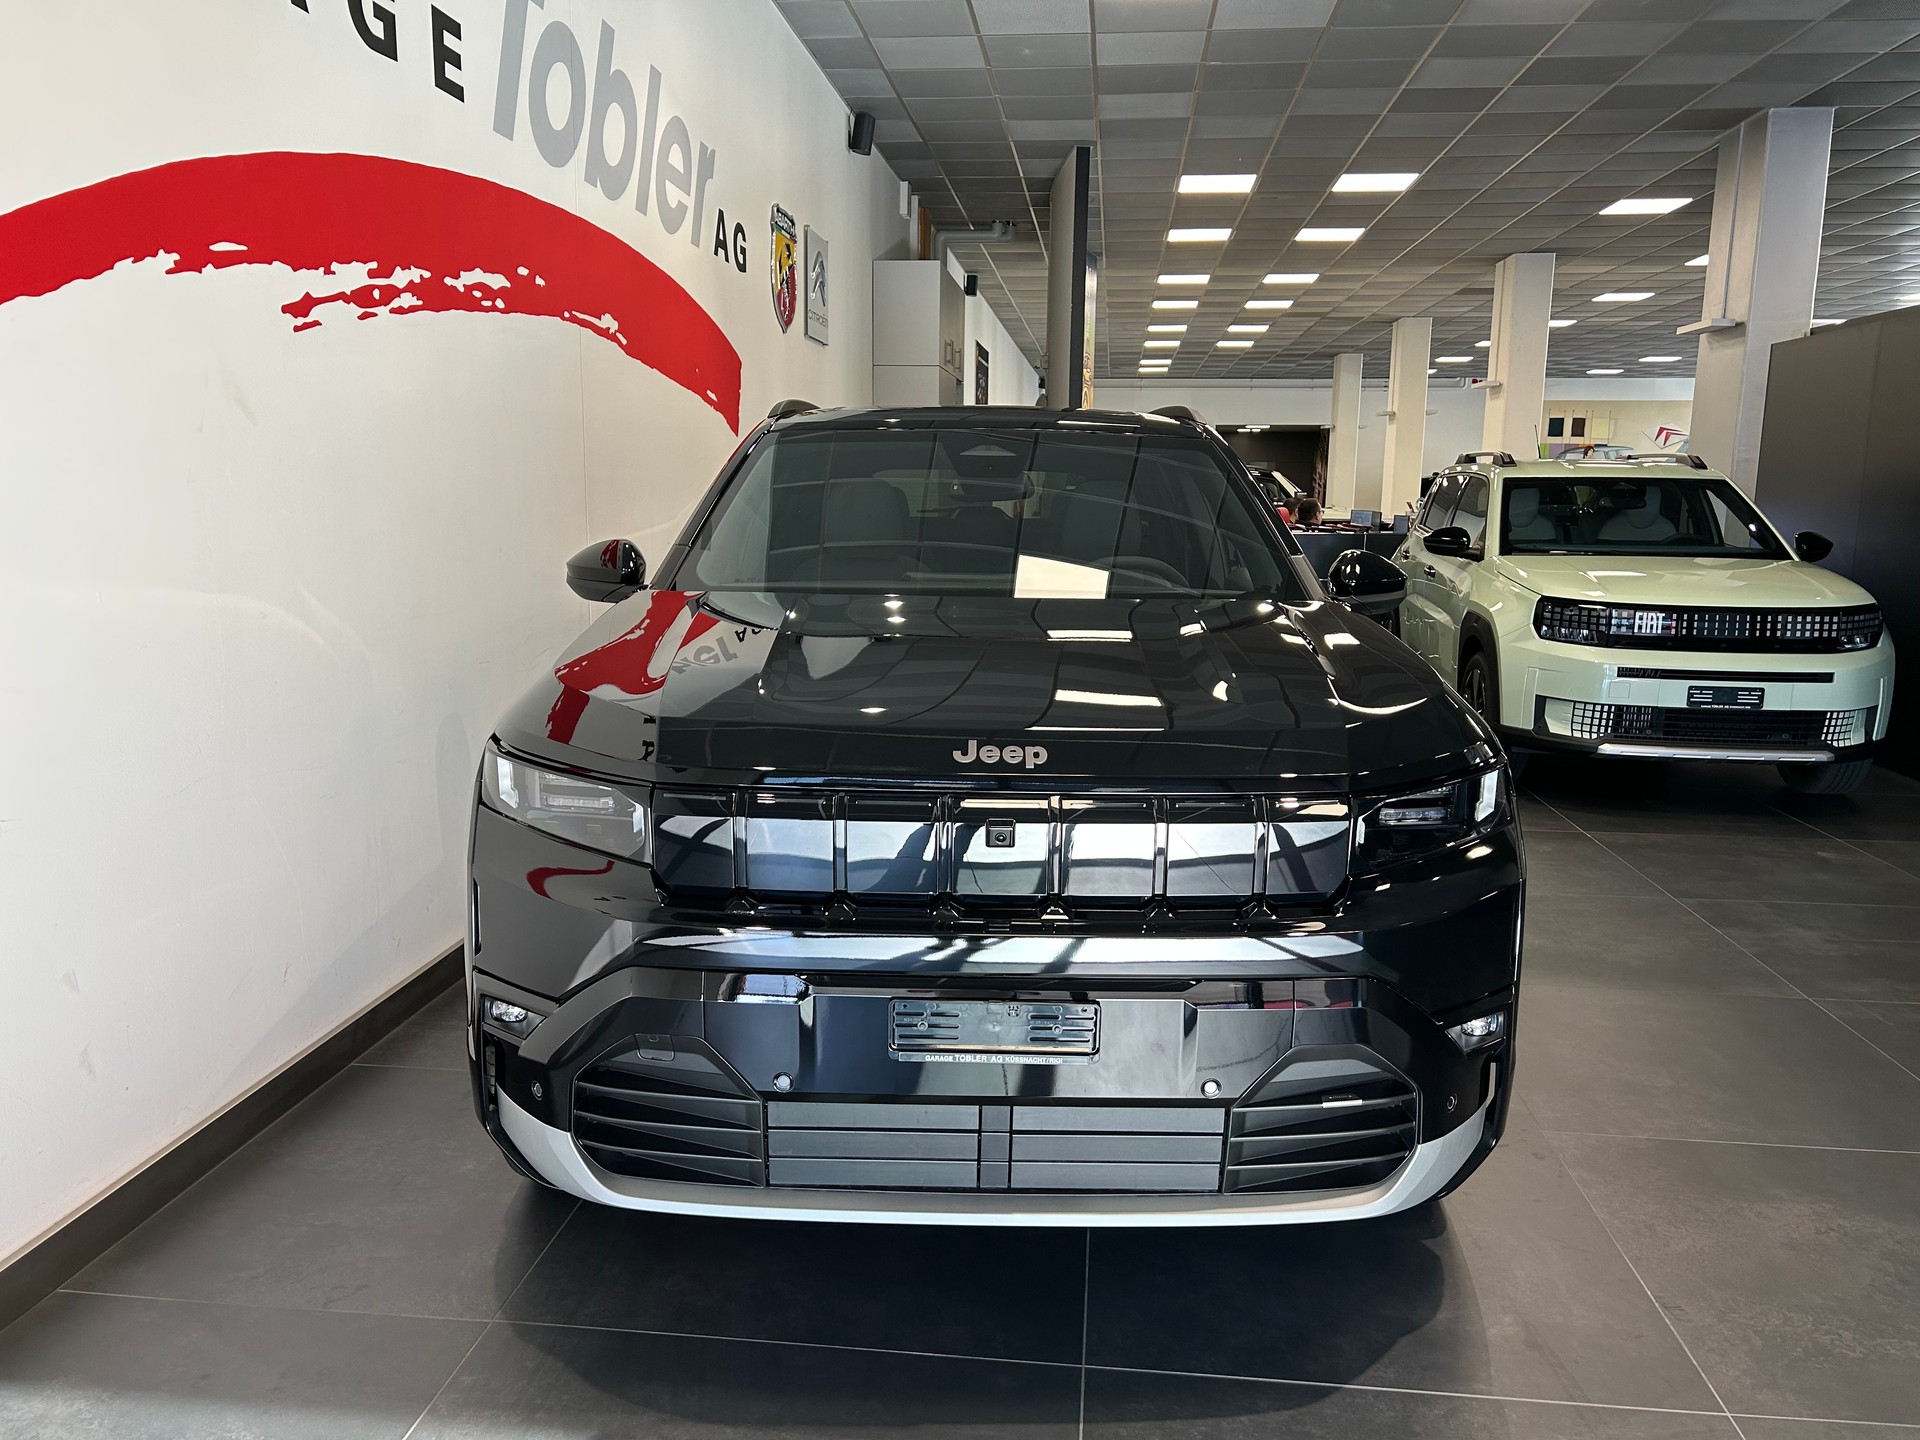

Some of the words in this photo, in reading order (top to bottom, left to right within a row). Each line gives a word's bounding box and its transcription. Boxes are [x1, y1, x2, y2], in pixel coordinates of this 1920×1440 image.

[290, 0, 465, 103] GE
[493, 0, 716, 248] Tobler
[713, 208, 747, 273] AG
[1633, 611, 1666, 634] FIAT
[952, 739, 1048, 769] Jeep
[925, 1054, 953, 1062] GARAGE
[955, 1053, 987, 1063] TOBLER
[990, 1055, 1003, 1063] AG
